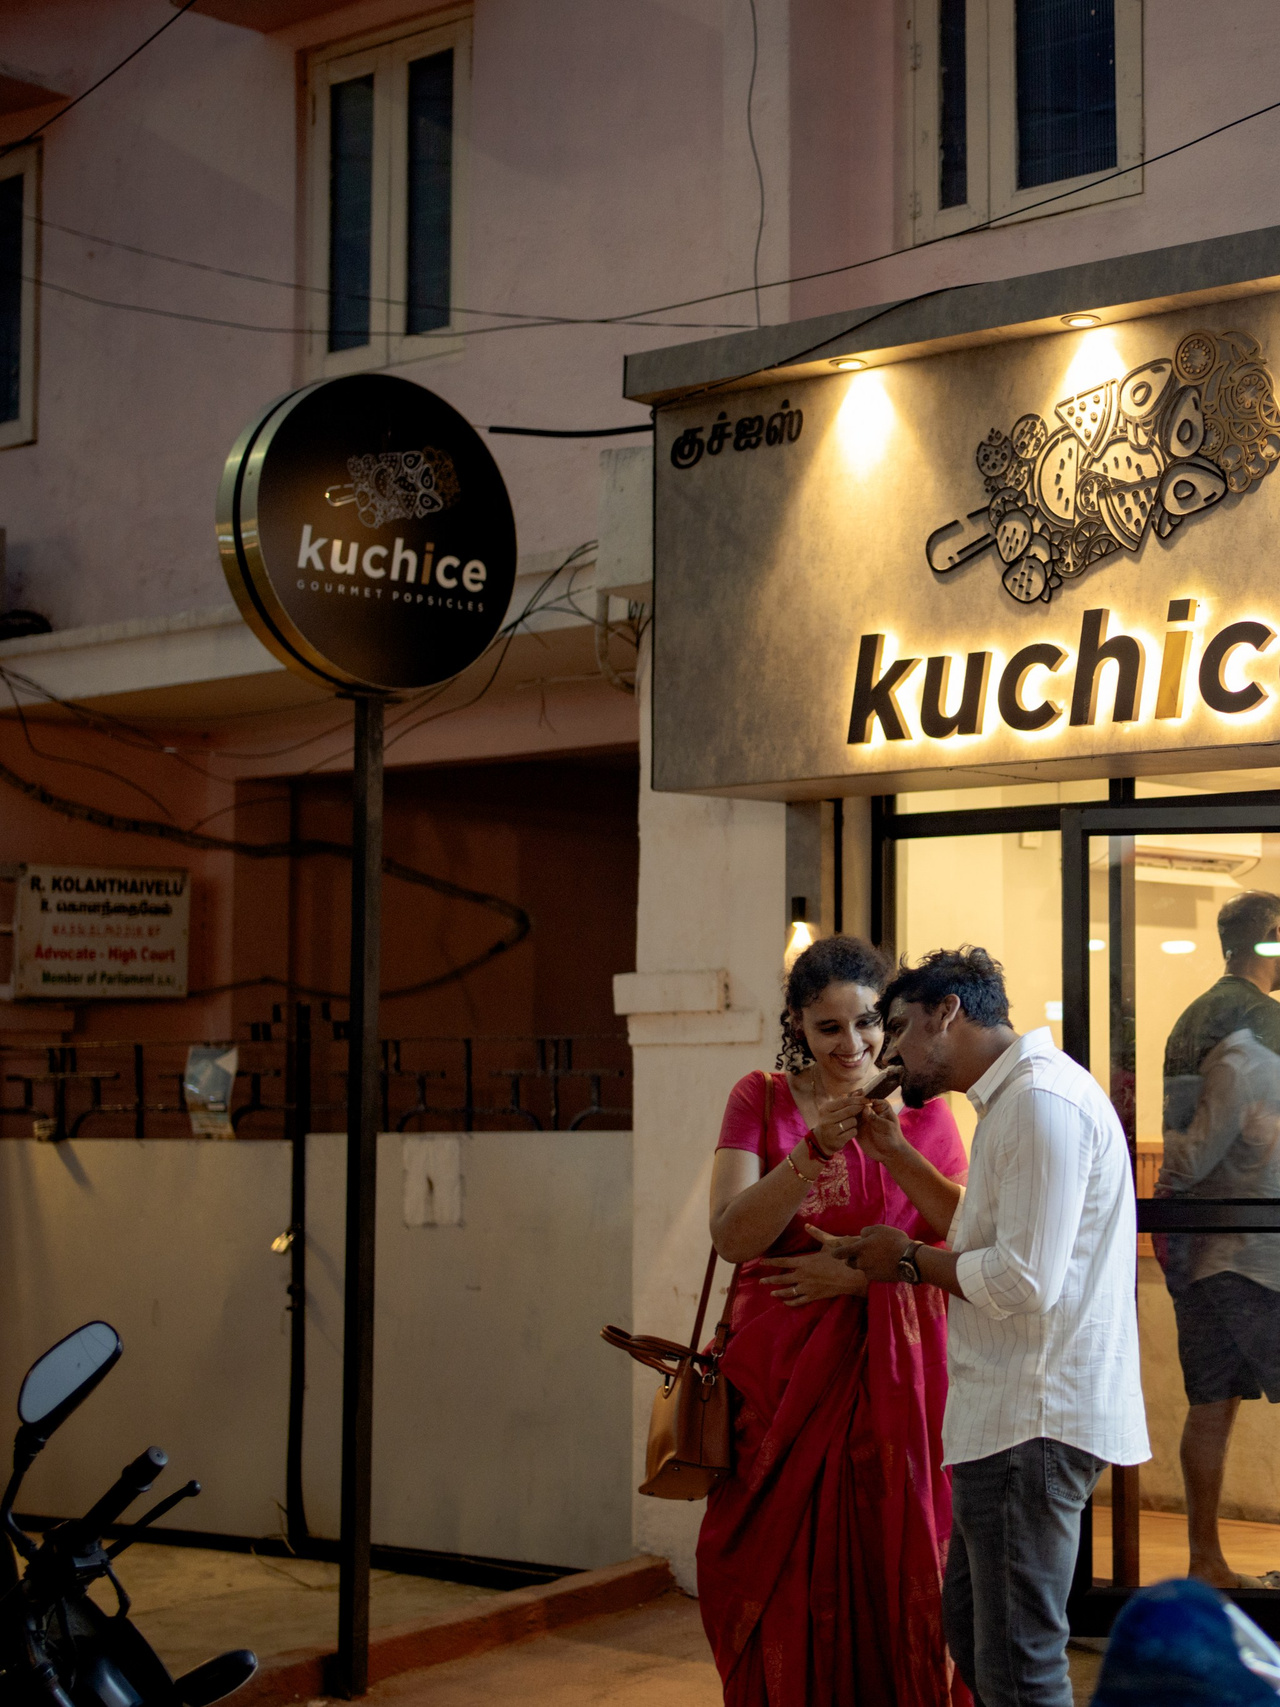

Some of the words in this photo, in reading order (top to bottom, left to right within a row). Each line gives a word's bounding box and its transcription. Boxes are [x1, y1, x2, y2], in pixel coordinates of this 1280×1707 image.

[671, 399, 804, 469] குச்ஐஸ்
[297, 523, 488, 593] kuchice
[297, 579, 383, 600] GOURMET
[392, 590, 485, 613] POPSICLES
[30, 876, 46, 892] R.
[52, 876, 184, 896] KOLANTHAIVELU
[34, 944, 97, 963] Advocate
[108, 946, 138, 965] High
[141, 947, 176, 963] Court
[42, 970, 83, 984] Member
[87, 971, 97, 984] of
[100, 970, 154, 985] Parliament
